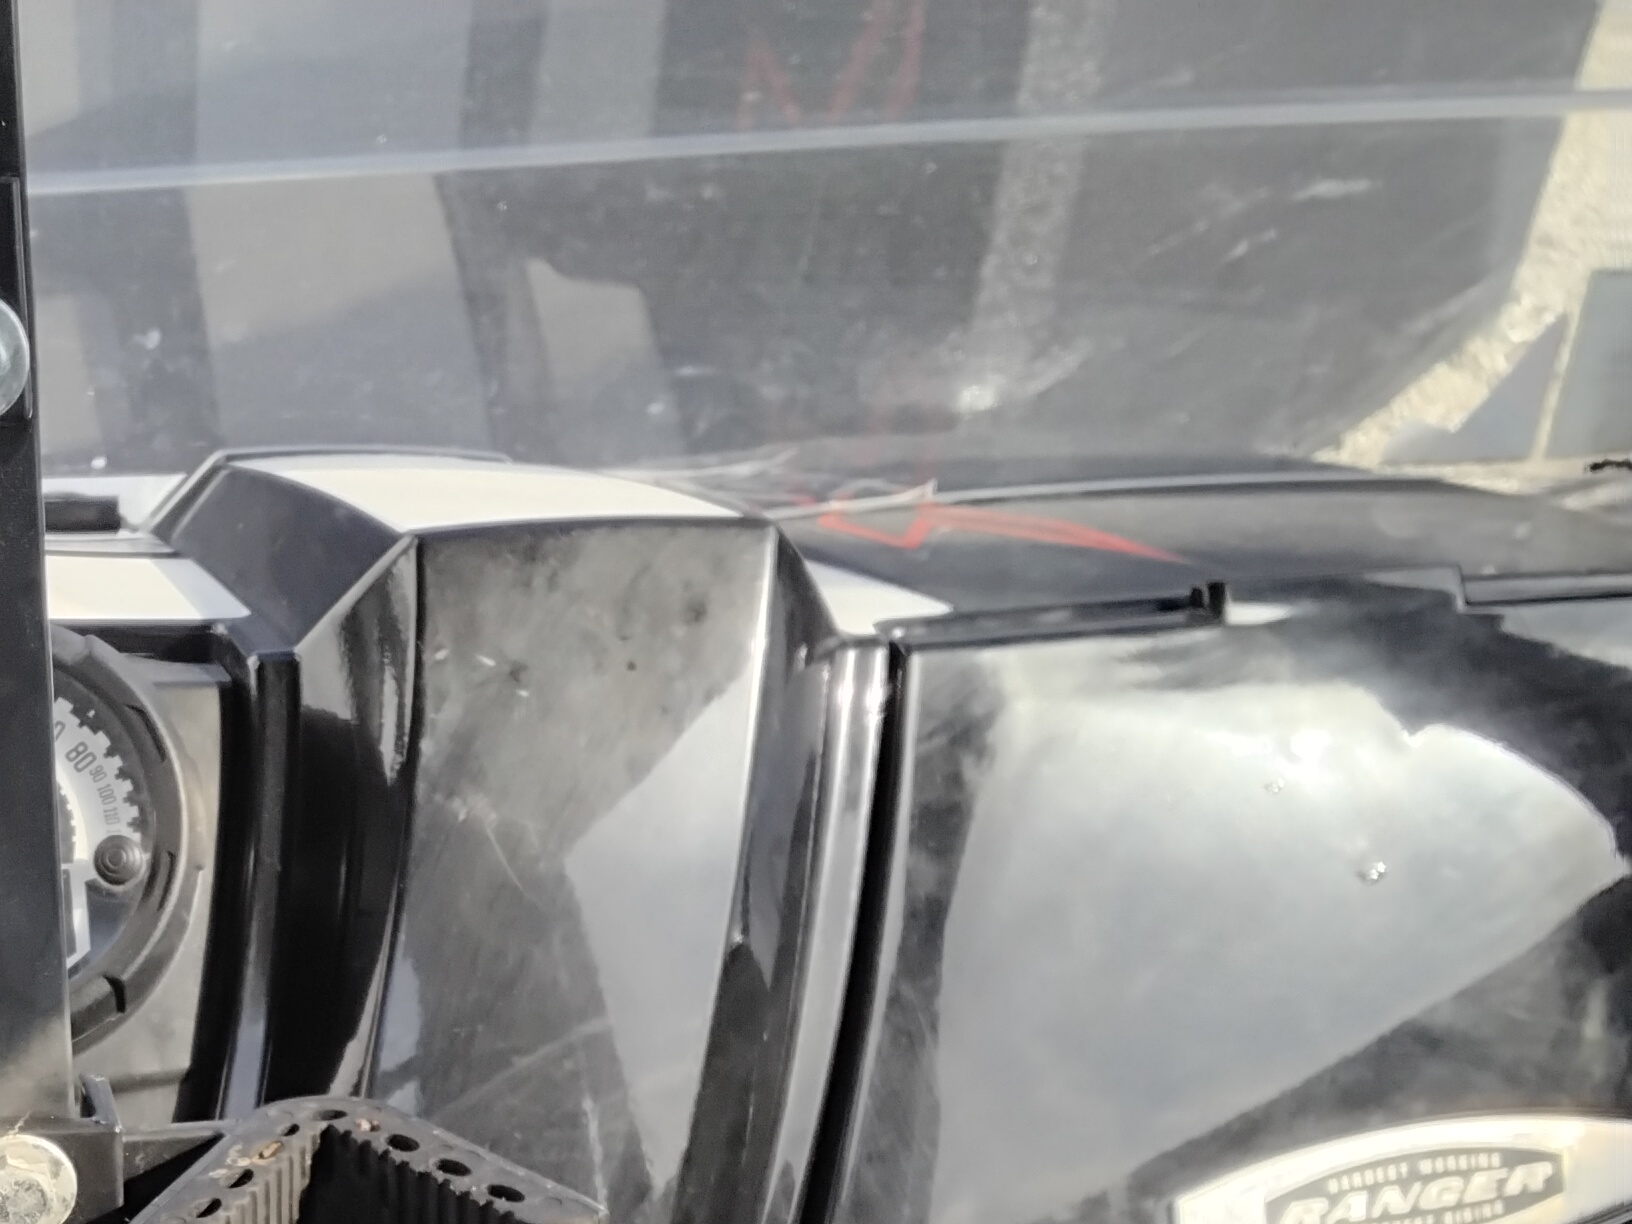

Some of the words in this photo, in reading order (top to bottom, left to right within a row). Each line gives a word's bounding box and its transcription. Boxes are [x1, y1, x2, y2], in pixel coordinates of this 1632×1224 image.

[65, 741, 97, 773] 80
[89, 765, 107, 783] 90
[97, 784, 117, 805] 100
[103, 807, 120, 826] 110
